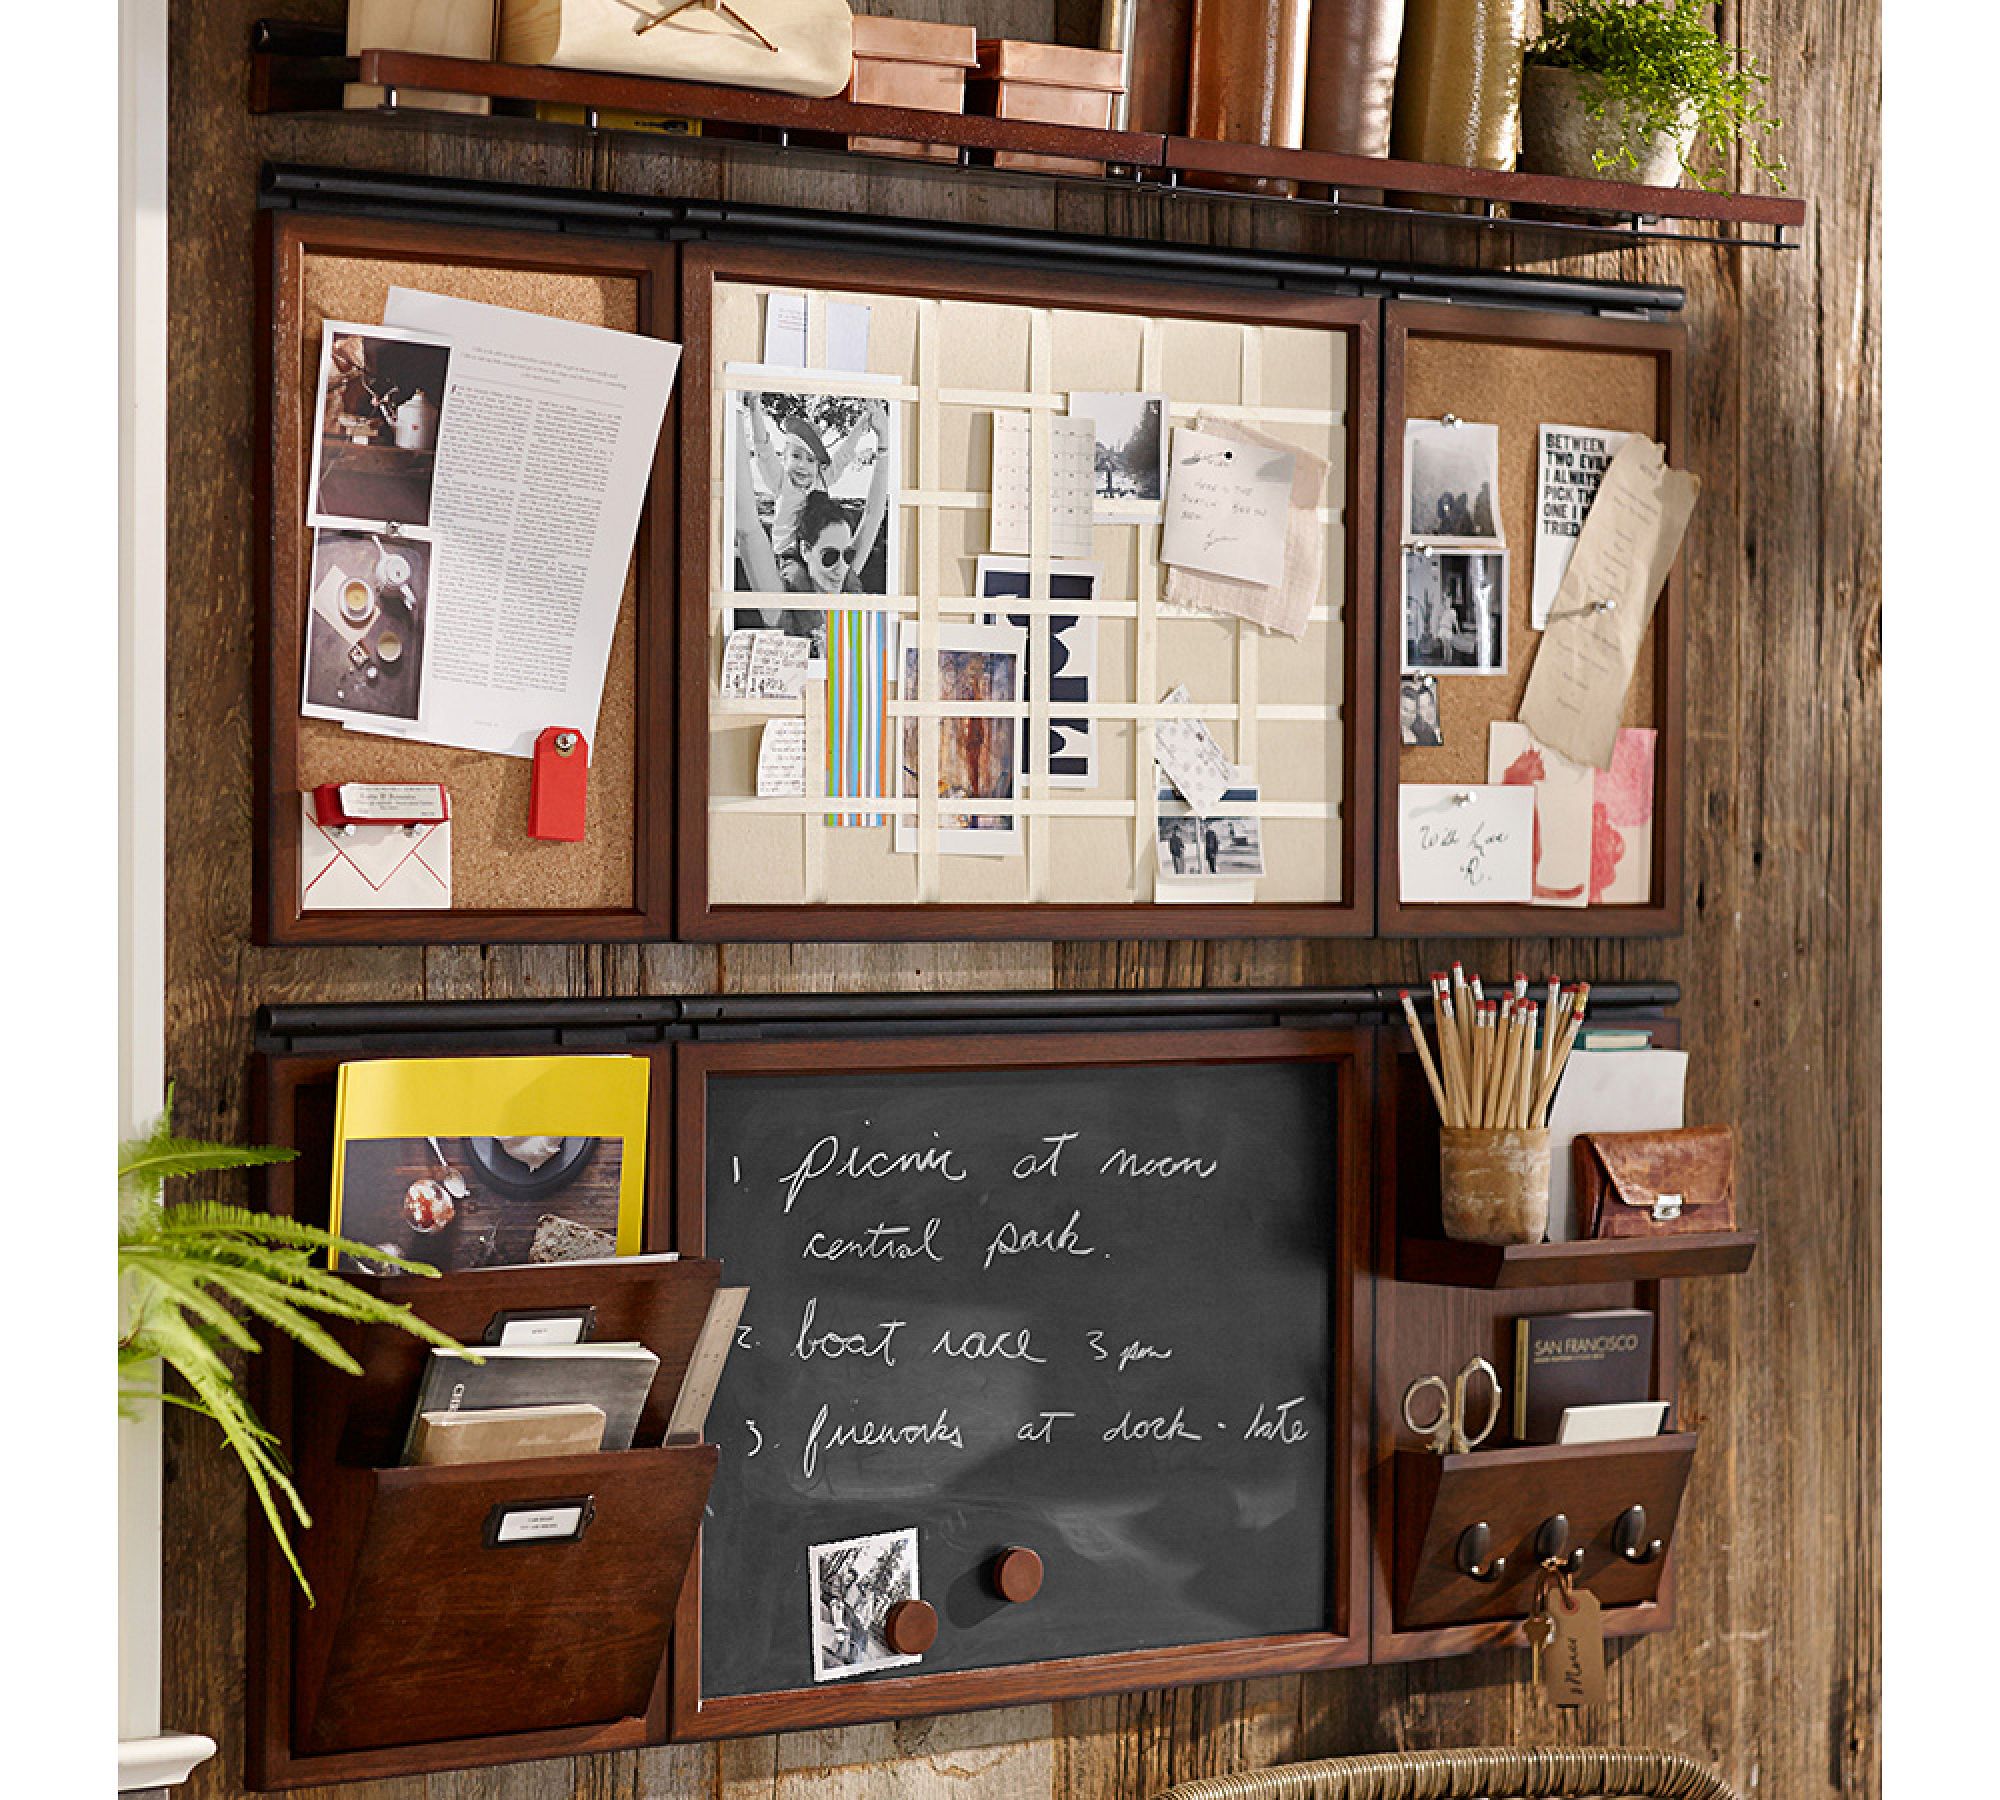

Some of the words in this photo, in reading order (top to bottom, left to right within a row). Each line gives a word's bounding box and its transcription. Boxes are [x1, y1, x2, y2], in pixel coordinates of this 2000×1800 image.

[1545, 433, 1606, 453] BETWEEN
[1546, 451, 1574, 467] TWO
[1544, 486, 1574, 502] PICK
[1544, 503, 1568, 518] ONE
[1543, 520, 1580, 537] TRIED
[779, 1119, 967, 1213] picnic
[1011, 1131, 1079, 1179] at
[1099, 1147, 1217, 1179] noon
[803, 1217, 943, 1261] central
[789, 1297, 907, 1367] boat
[931, 1329, 1047, 1363] race
[1534, 1339, 1562, 1357] SAN
[1565, 1333, 1639, 1354] FRANCISCO
[803, 1400, 963, 1479] fireworks
[1017, 1411, 1075, 1443] at
[1103, 1407, 1203, 1441] dock
[1243, 1397, 1309, 1443] late
